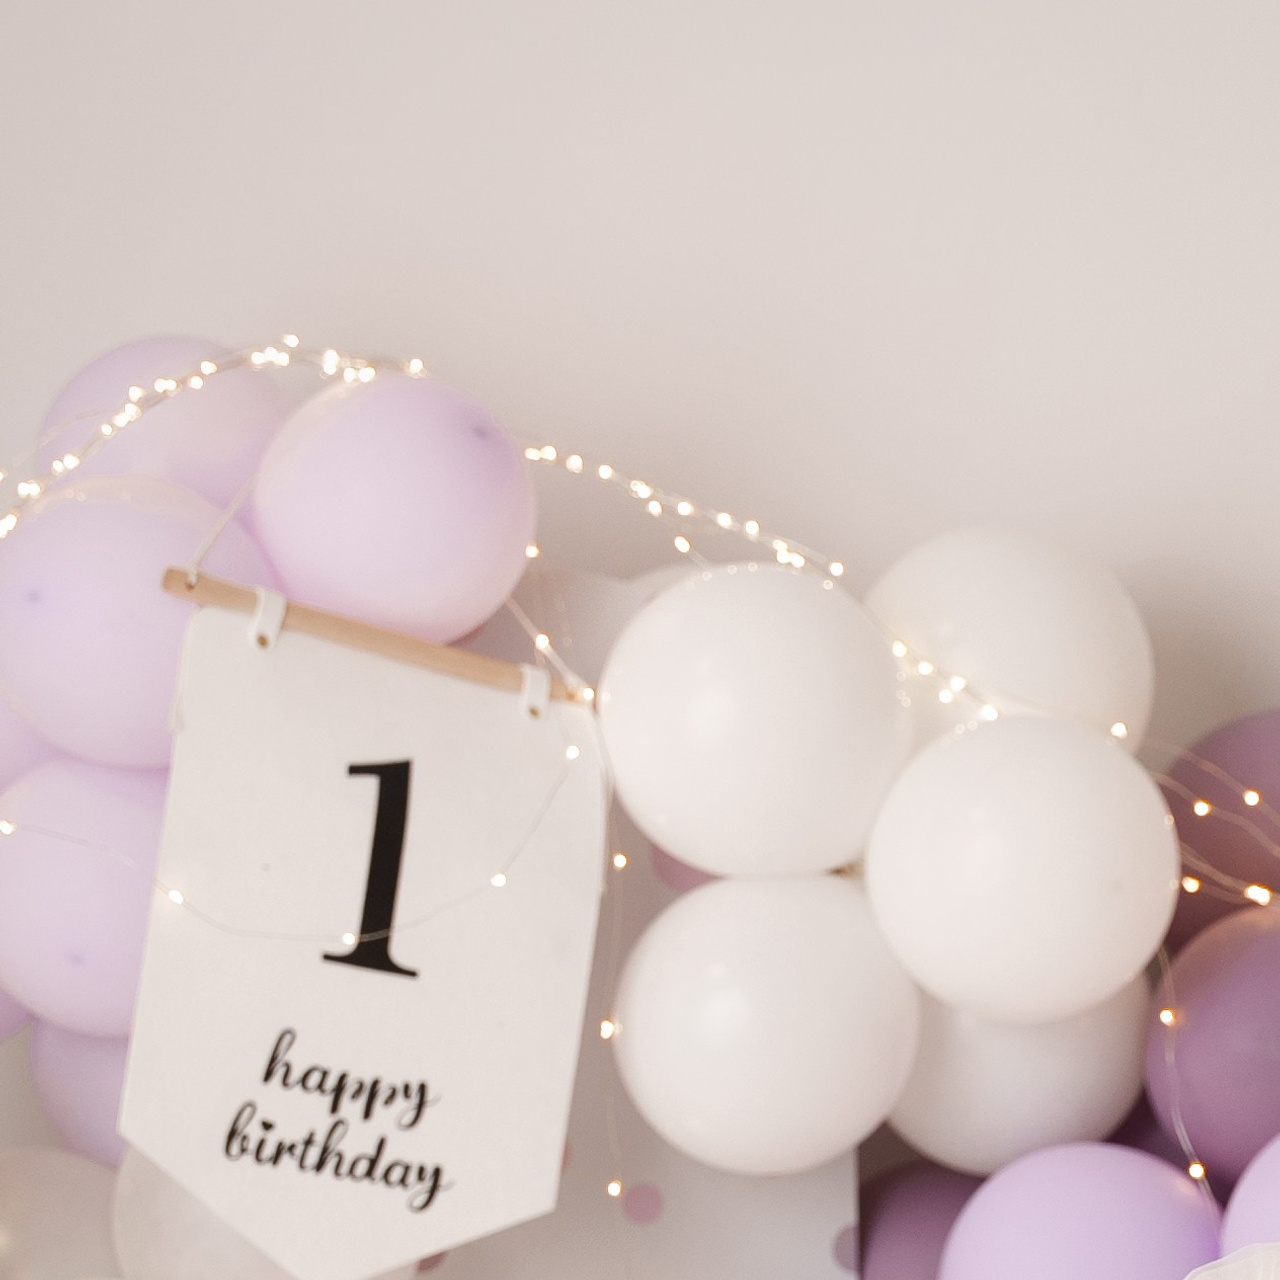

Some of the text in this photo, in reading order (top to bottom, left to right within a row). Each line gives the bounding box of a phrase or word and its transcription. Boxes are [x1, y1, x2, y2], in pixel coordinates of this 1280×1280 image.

[322, 759, 419, 979] 1
[261, 1027, 438, 1129] happy
[224, 1101, 452, 1212] birthday
